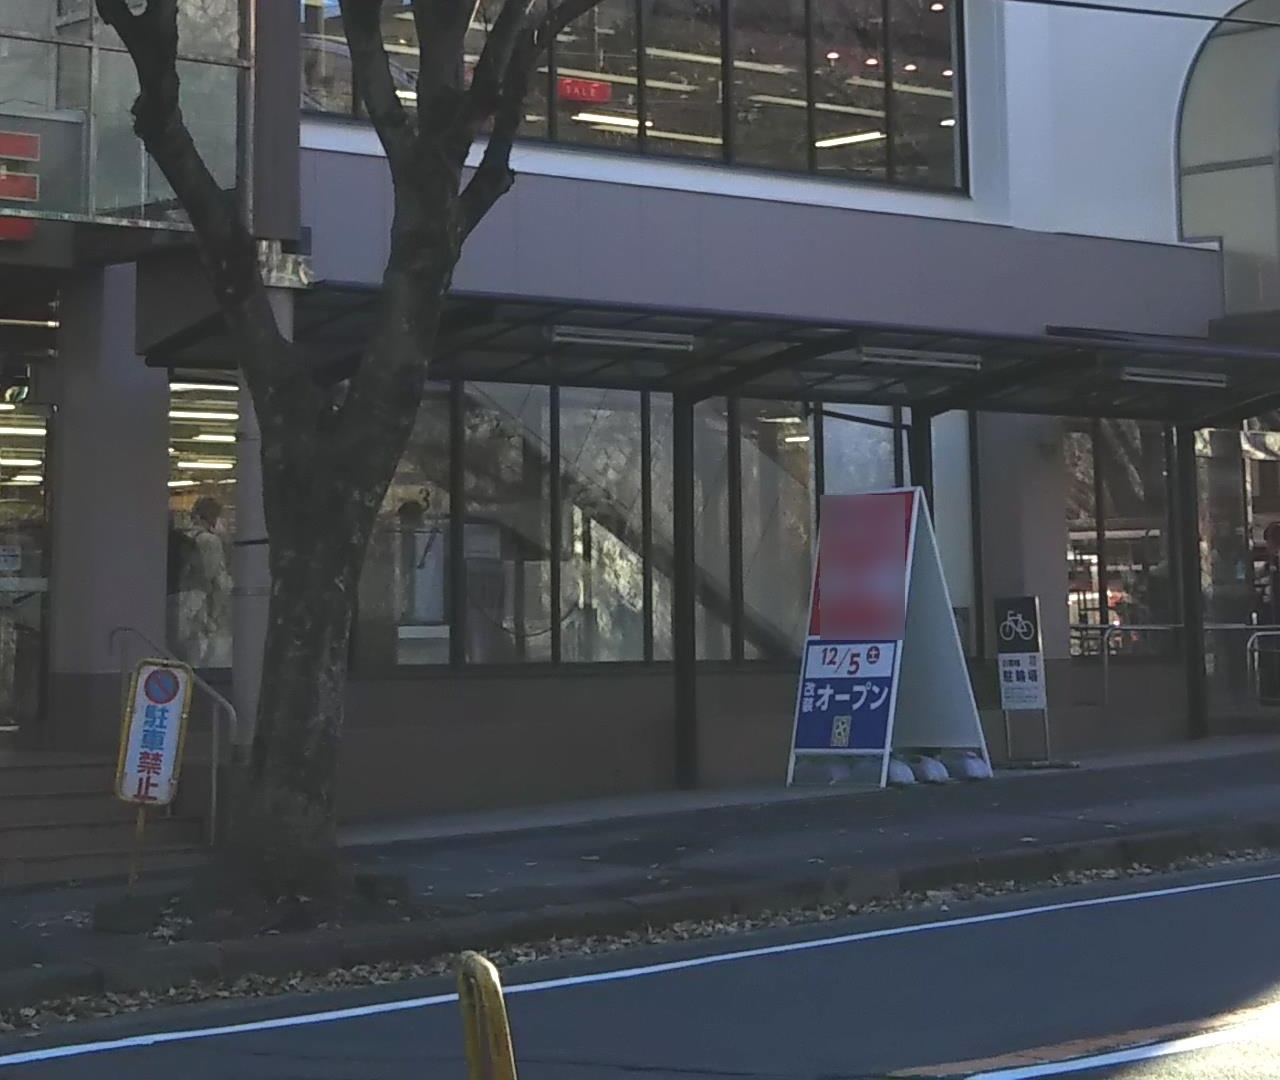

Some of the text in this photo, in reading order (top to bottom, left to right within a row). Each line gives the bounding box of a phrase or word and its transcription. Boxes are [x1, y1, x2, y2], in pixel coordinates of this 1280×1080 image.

[821, 647, 860, 675] 12/5
[815, 681, 889, 712] オープン
[133, 705, 169, 801] 駐車禁止
